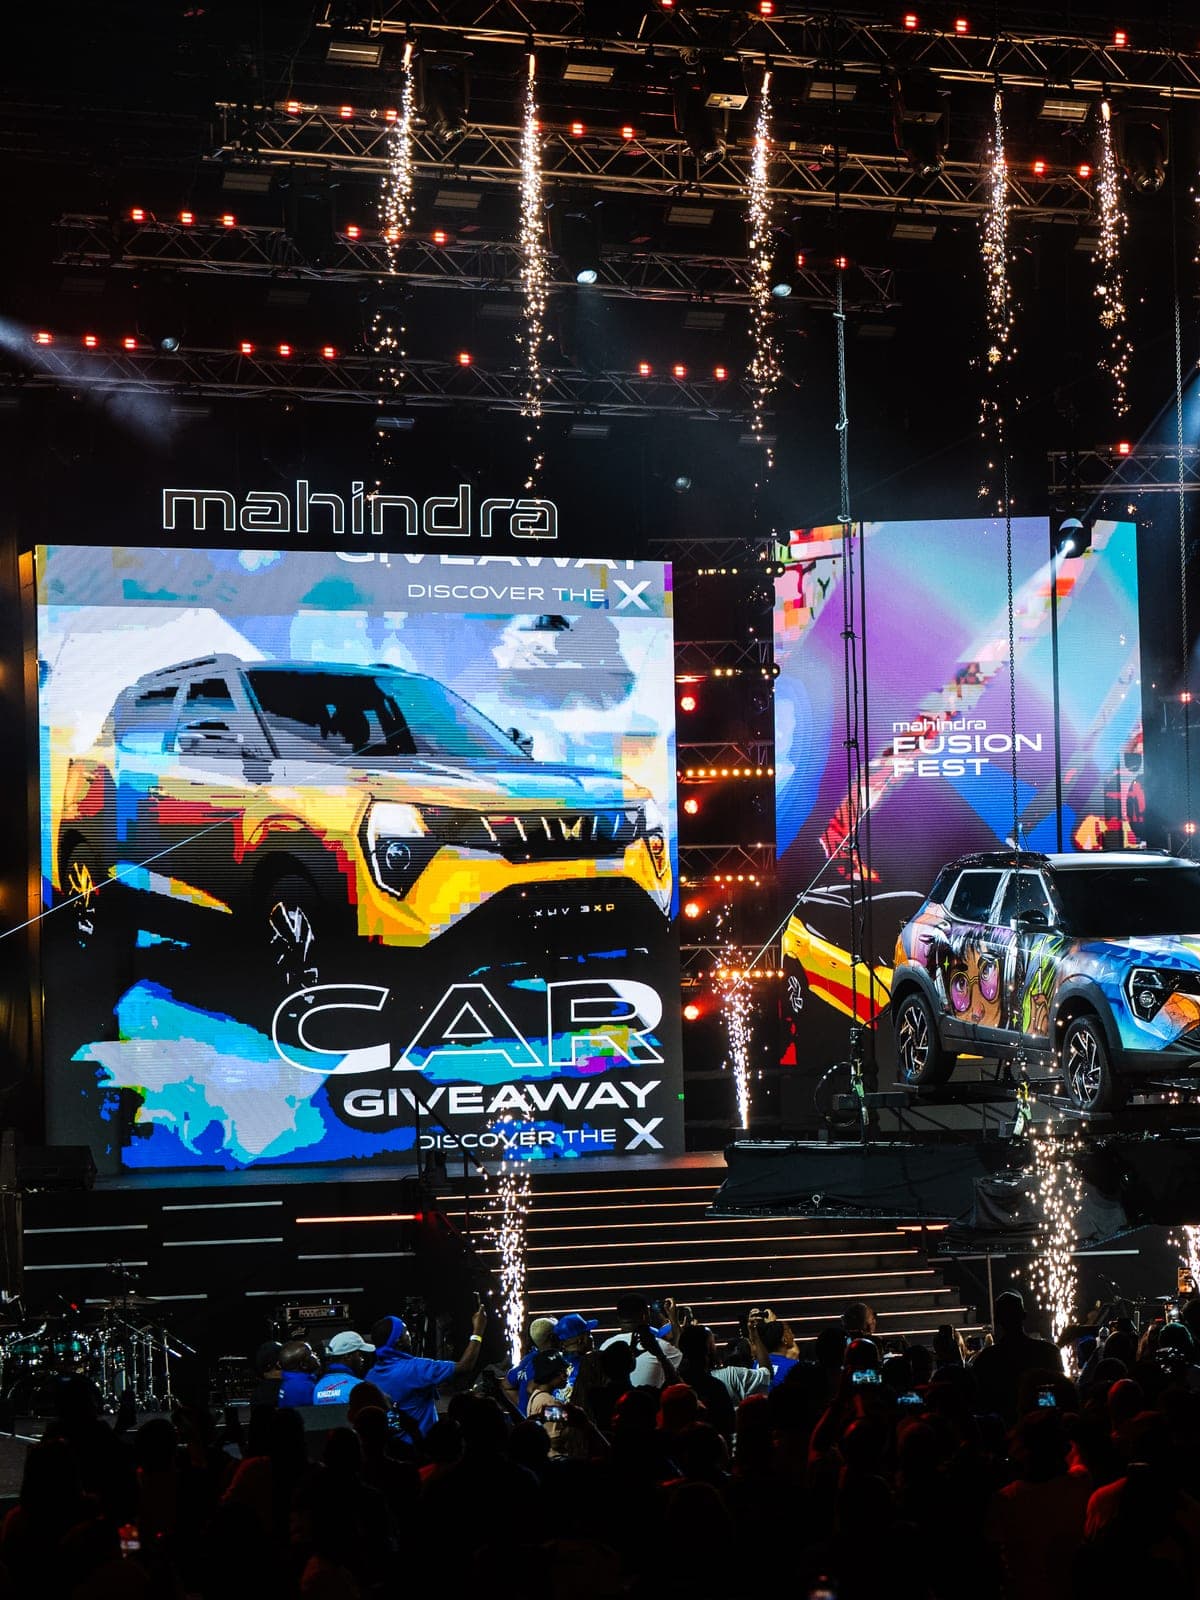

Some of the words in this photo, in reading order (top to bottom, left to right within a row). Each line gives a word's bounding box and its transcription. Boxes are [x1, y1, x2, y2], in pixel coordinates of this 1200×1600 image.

[161, 478, 559, 541] mahindra
[407, 584, 545, 601] DISCOVER
[551, 586, 606, 602] THE
[612, 579, 652, 611] X
[892, 717, 987, 733] mahindra
[892, 733, 1043, 755] FUSION
[892, 758, 990, 778] FEST
[271, 977, 665, 1074] CAR
[343, 1080, 661, 1118] GIVEAWAY
[419, 1131, 556, 1150] DISCOVER
[562, 1128, 617, 1144] THE
[623, 1117, 665, 1150] X
